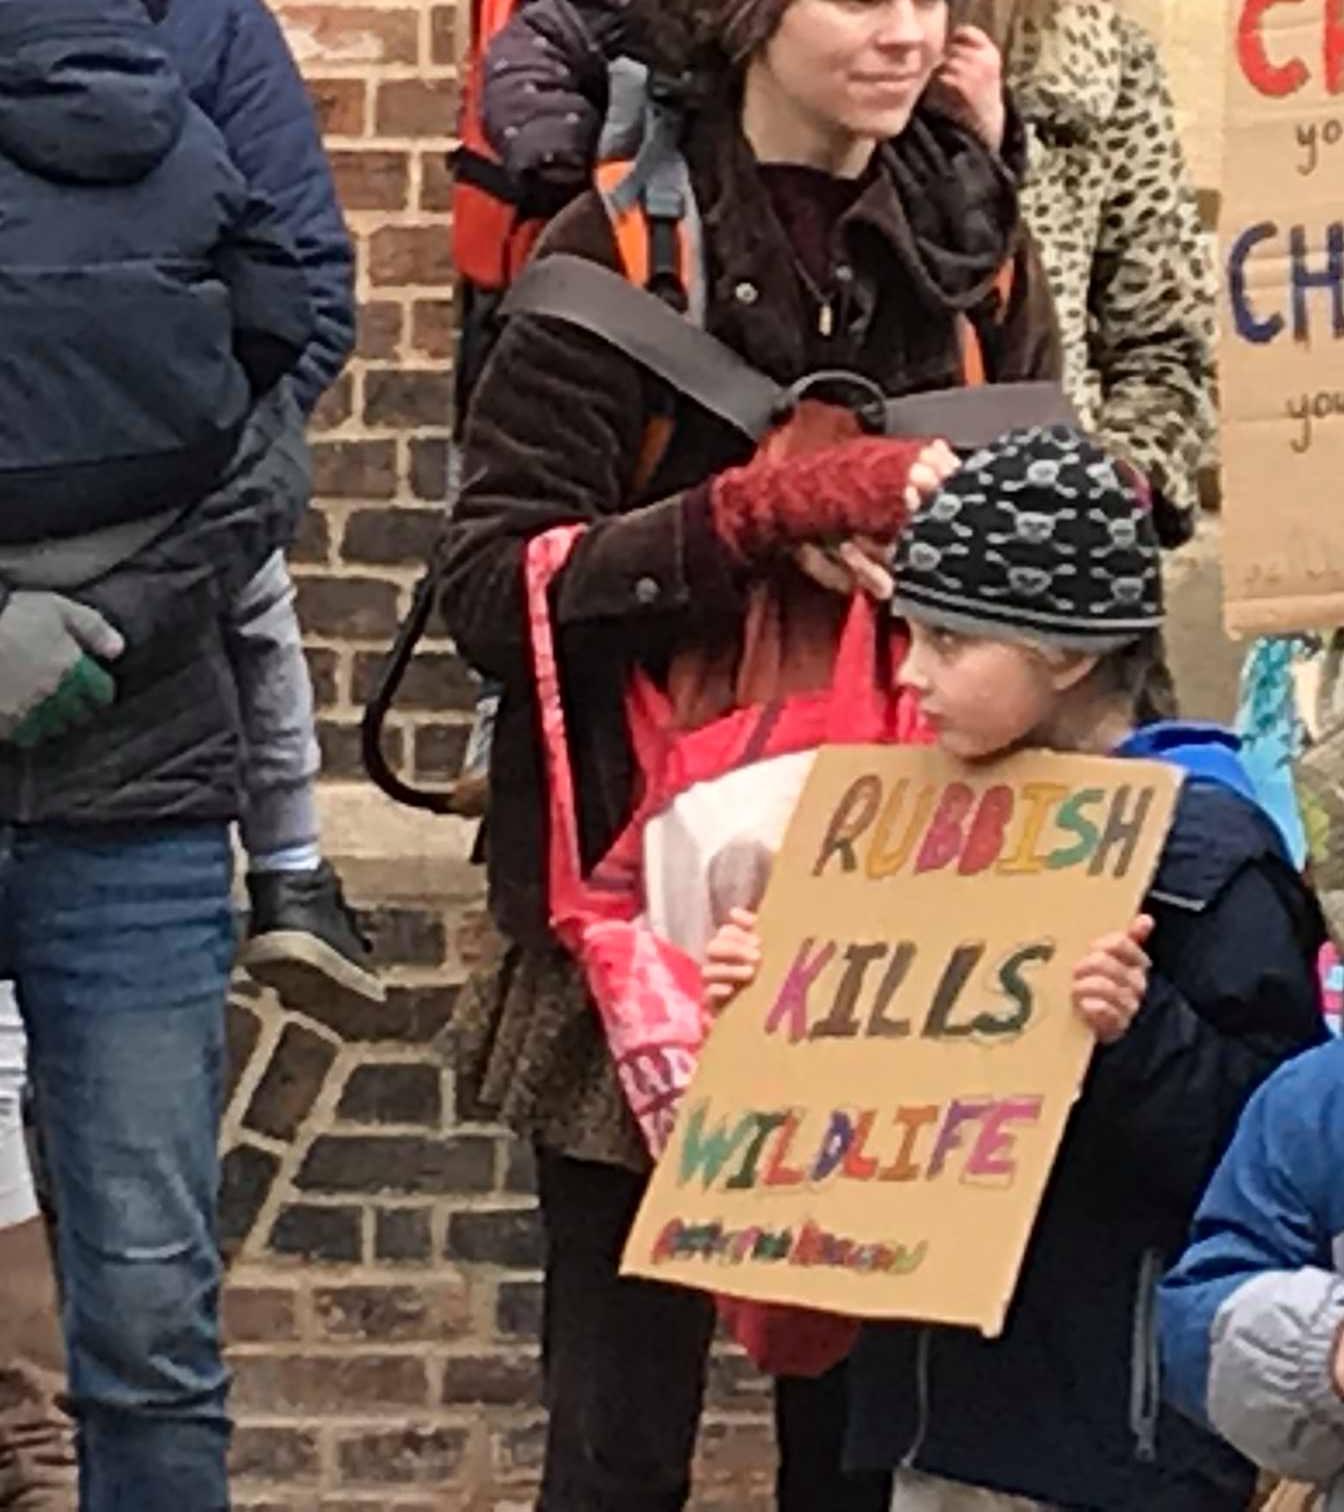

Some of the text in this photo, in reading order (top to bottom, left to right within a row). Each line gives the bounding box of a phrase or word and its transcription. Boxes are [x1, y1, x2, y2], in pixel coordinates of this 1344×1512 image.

[811, 774, 1155, 880] RUBBISH
[764, 935, 1058, 1045] KILLS
[676, 1096, 1045, 1195] WILDLIFE
